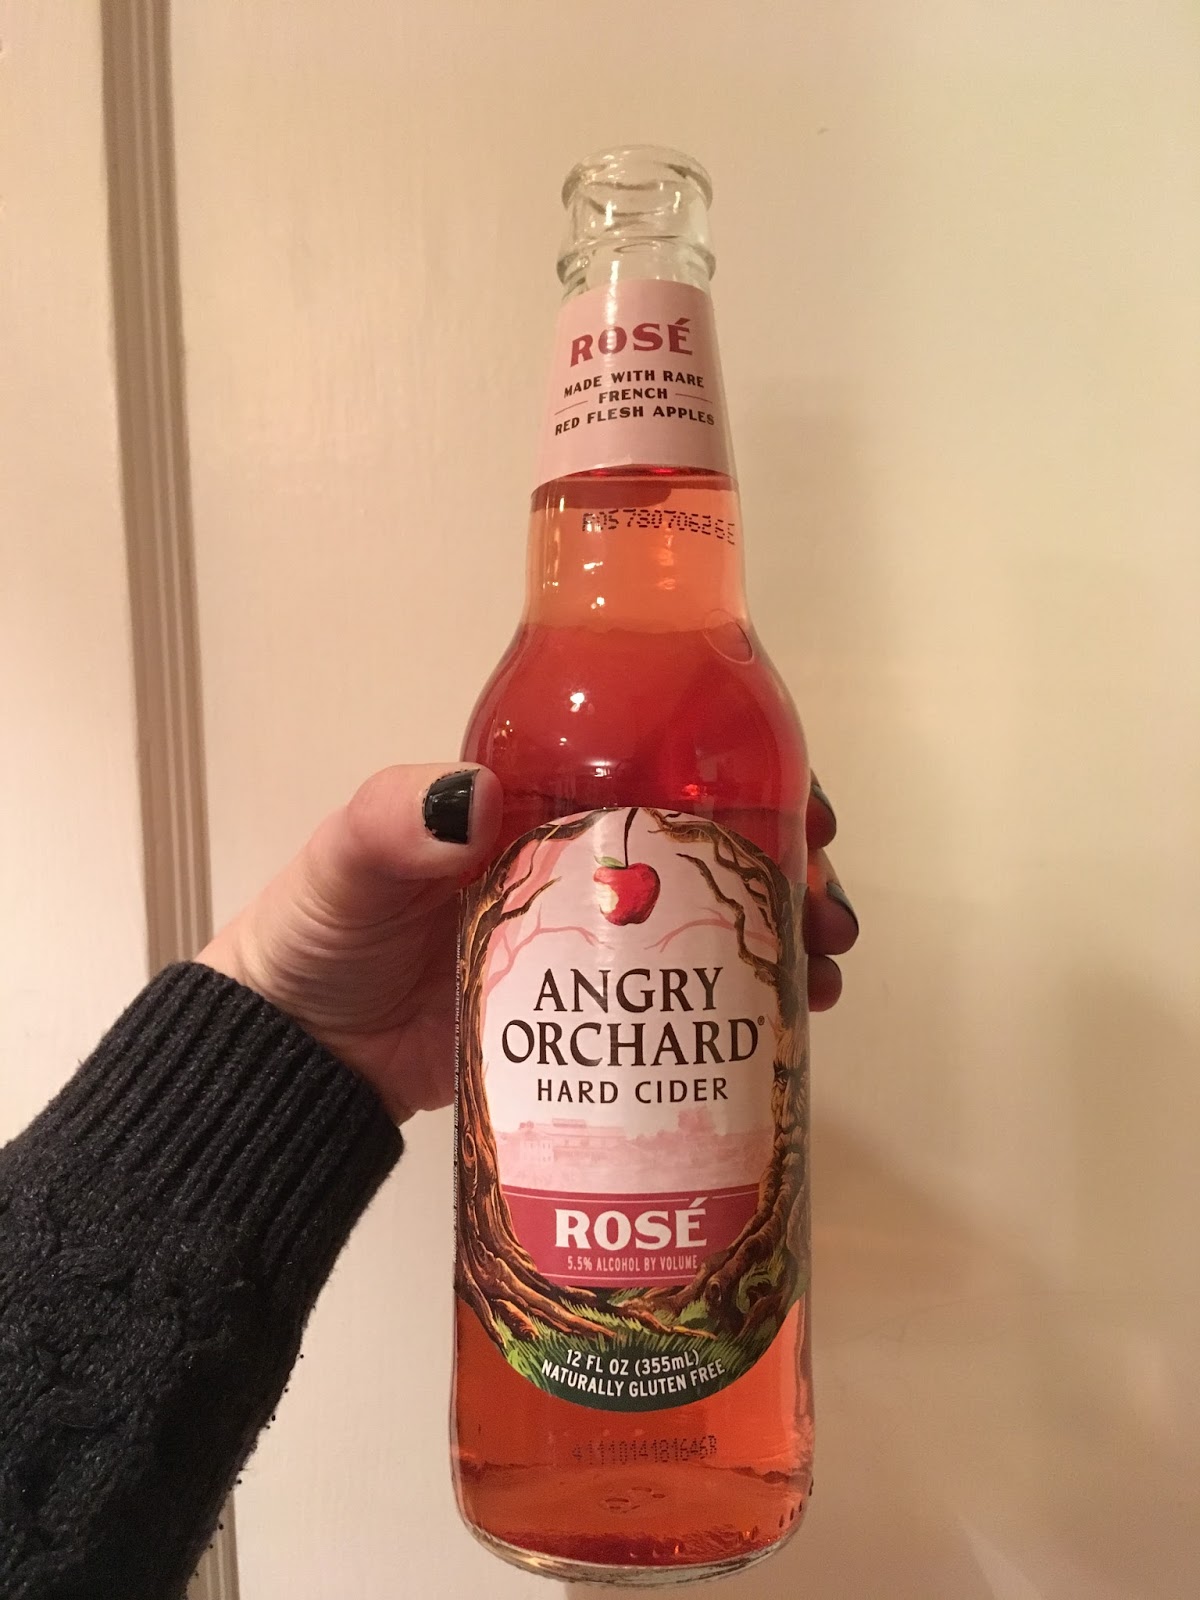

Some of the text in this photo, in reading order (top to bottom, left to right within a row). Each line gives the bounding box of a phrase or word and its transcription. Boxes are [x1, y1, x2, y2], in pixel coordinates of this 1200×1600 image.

[570, 317, 693, 367] ROSÉ
[563, 370, 705, 399] MADE WITH RARE
[598, 388, 668, 404] FRENCH
[555, 406, 715, 436] RED FLESH APPLES
[533, 967, 724, 1014] ANGRY
[538, 1077, 729, 1103] HARD CIDER
[555, 1197, 708, 1251] ROSÉ
[567, 1254, 698, 1272] 5.5% ALCOHOL BY VOLUME
[541, 1358, 726, 1397] NATURALLY GLUTEN FREE
[566, 1349, 700, 1377] 12 FL OZ (355mL)
